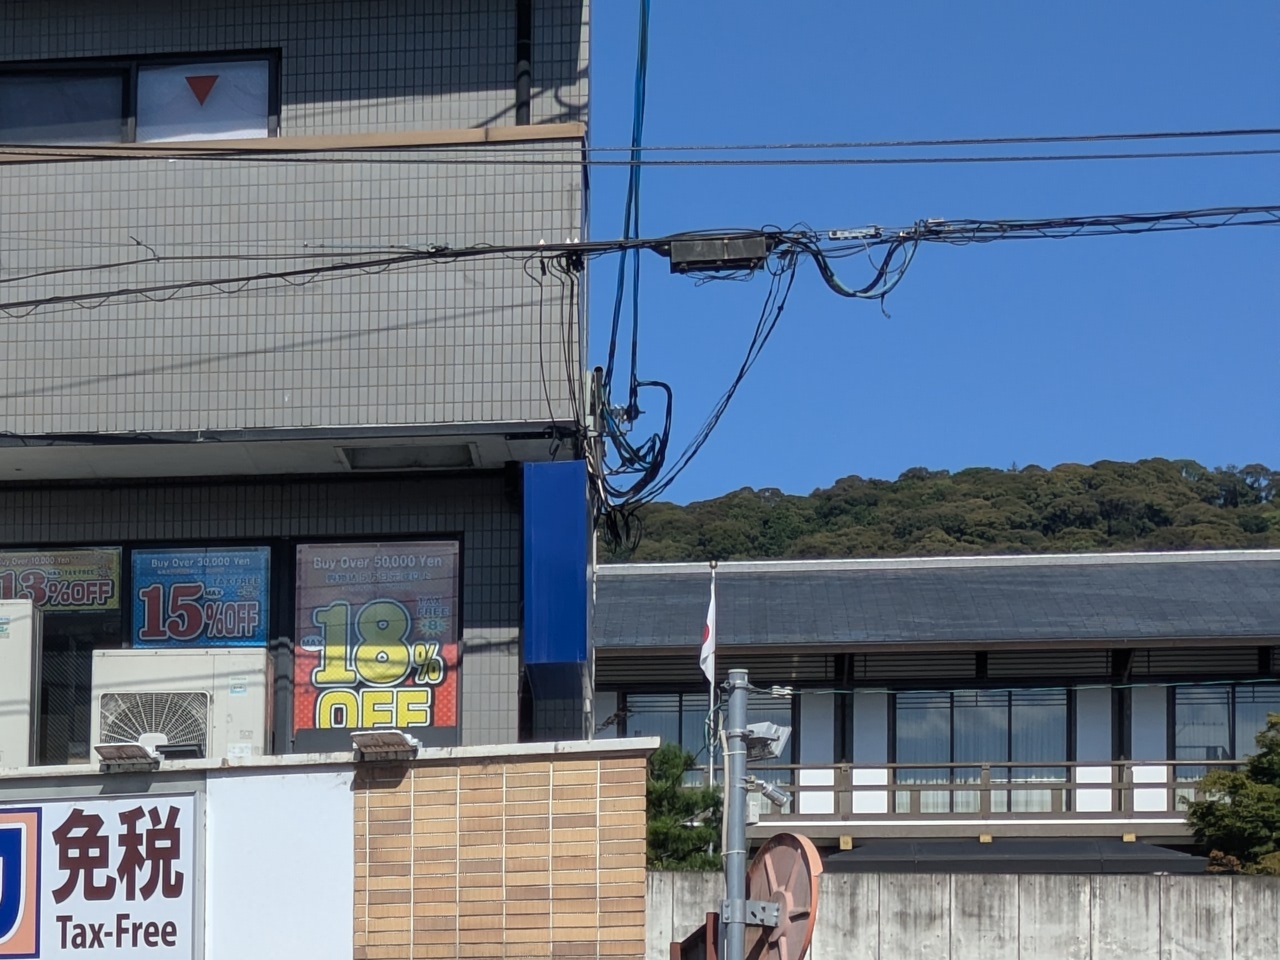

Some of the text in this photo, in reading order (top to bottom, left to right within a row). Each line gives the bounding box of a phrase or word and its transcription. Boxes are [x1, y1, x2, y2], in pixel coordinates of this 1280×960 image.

[151, 556, 250, 568] Buy Over 30,000 Yen
[313, 555, 442, 569] Buy Over 50,000 Yen
[417, 606, 450, 616] FREE
[301, 638, 324, 647] MAX
[51, 804, 185, 905] 免税
[56, 913, 178, 950] Tax-Free
